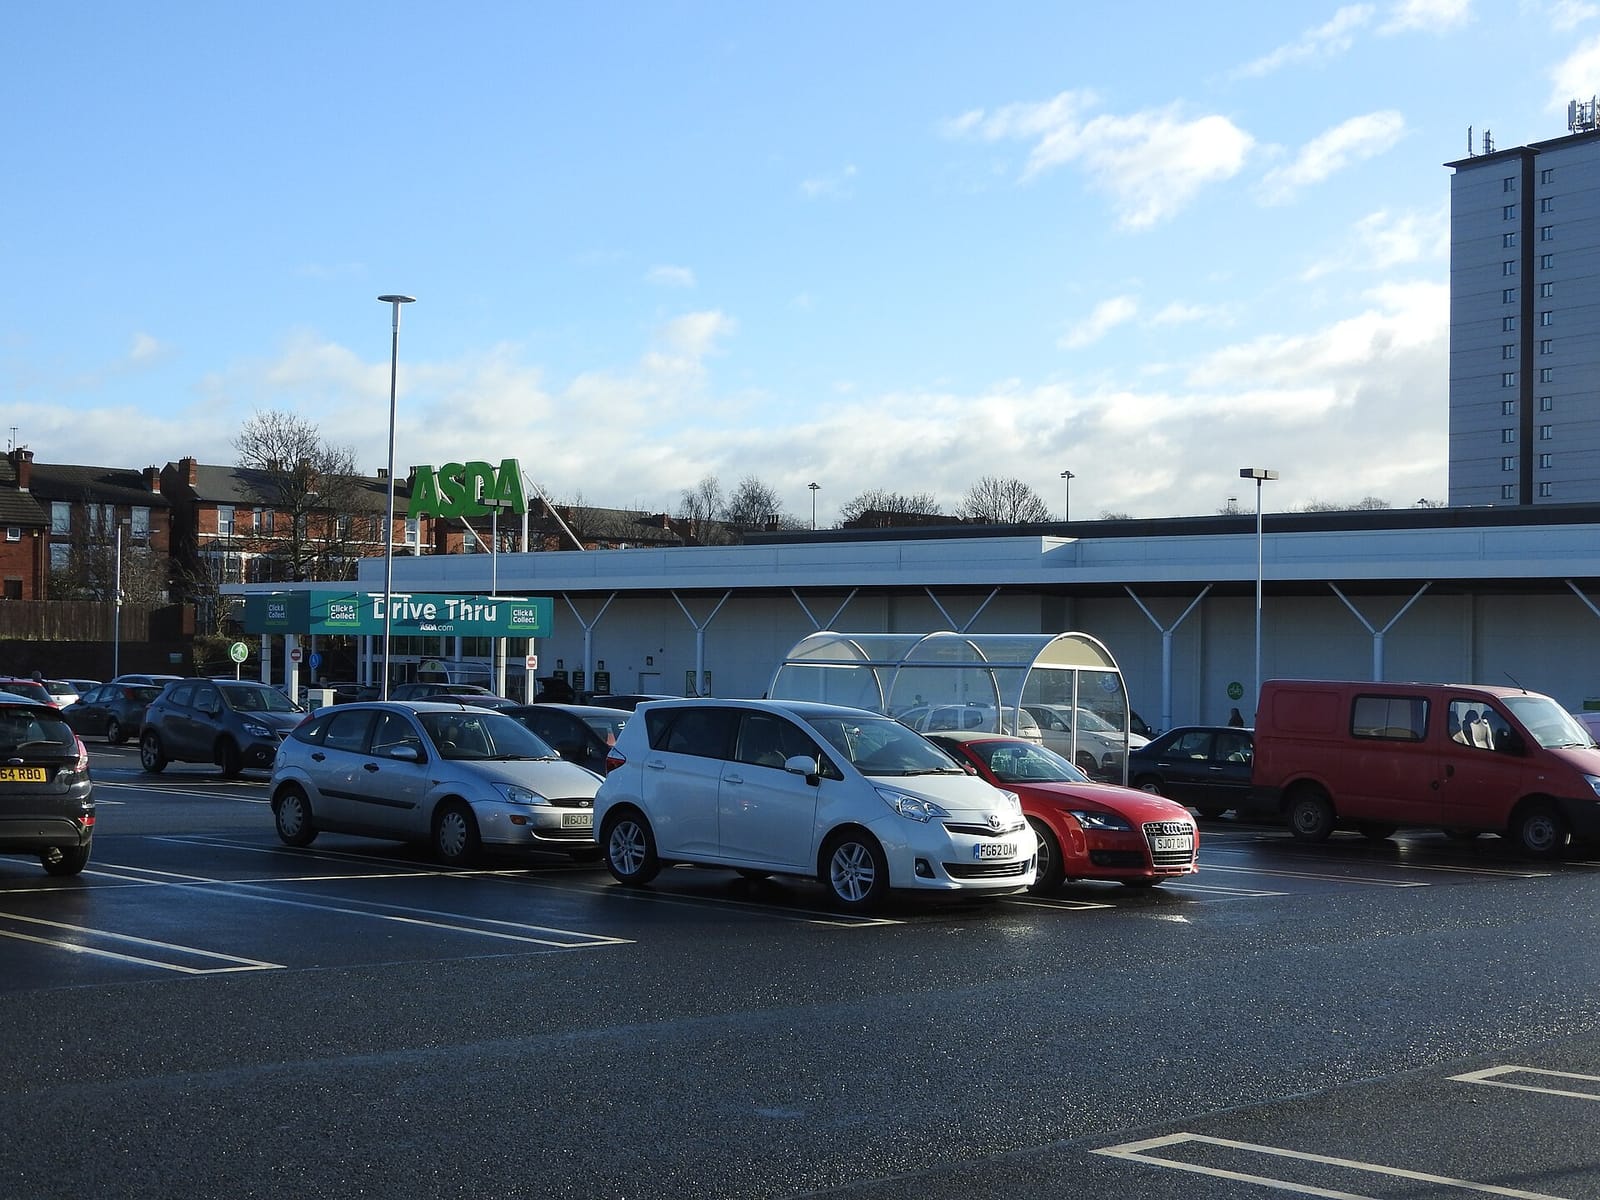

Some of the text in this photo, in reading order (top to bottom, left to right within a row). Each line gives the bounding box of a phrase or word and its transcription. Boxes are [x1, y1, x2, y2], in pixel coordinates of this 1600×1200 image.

[408, 458, 527, 519] ASDA
[373, 597, 497, 621] Drive Thru
[330, 612, 355, 620] Collect
[18, 769, 41, 780] RBO
[980, 844, 1002, 856] FG62
